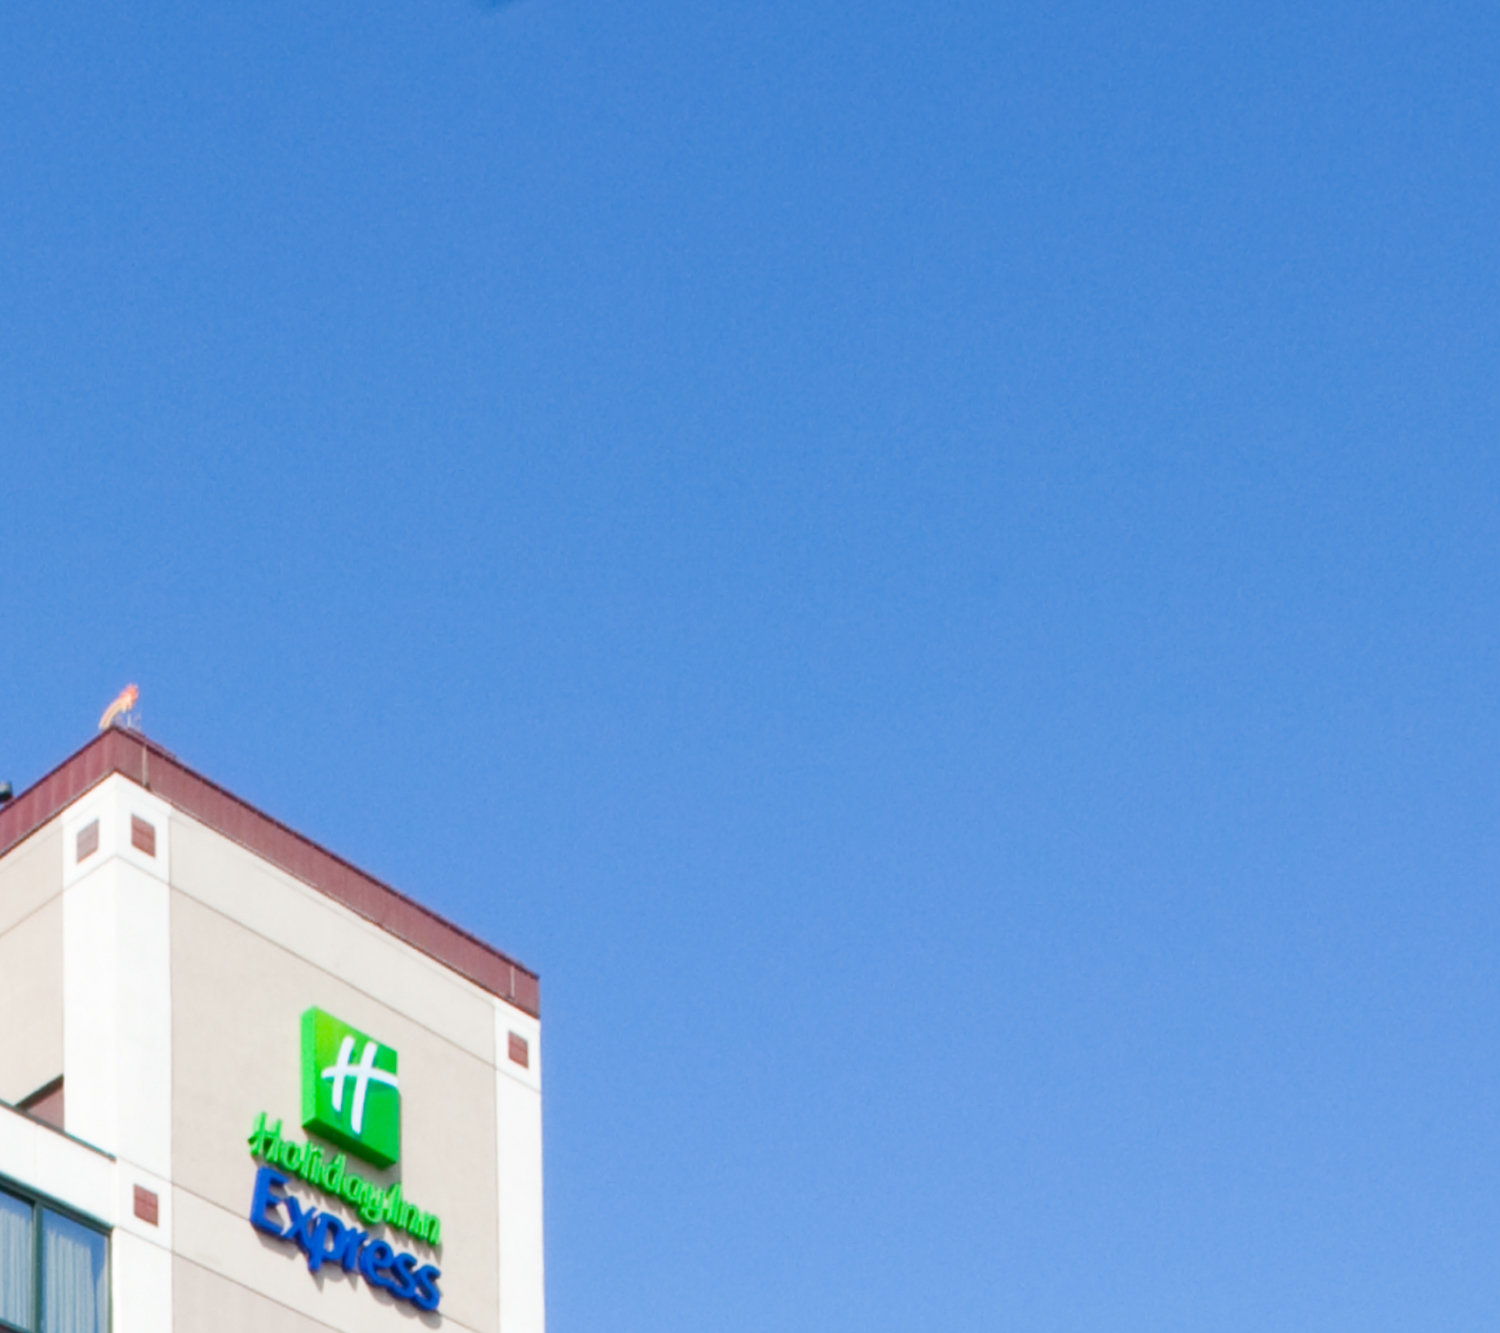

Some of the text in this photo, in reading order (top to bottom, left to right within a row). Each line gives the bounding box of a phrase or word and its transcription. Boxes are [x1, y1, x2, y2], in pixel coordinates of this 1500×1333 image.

[248, 1111, 442, 1246] Holiday Inn
[250, 1165, 442, 1311] Express
